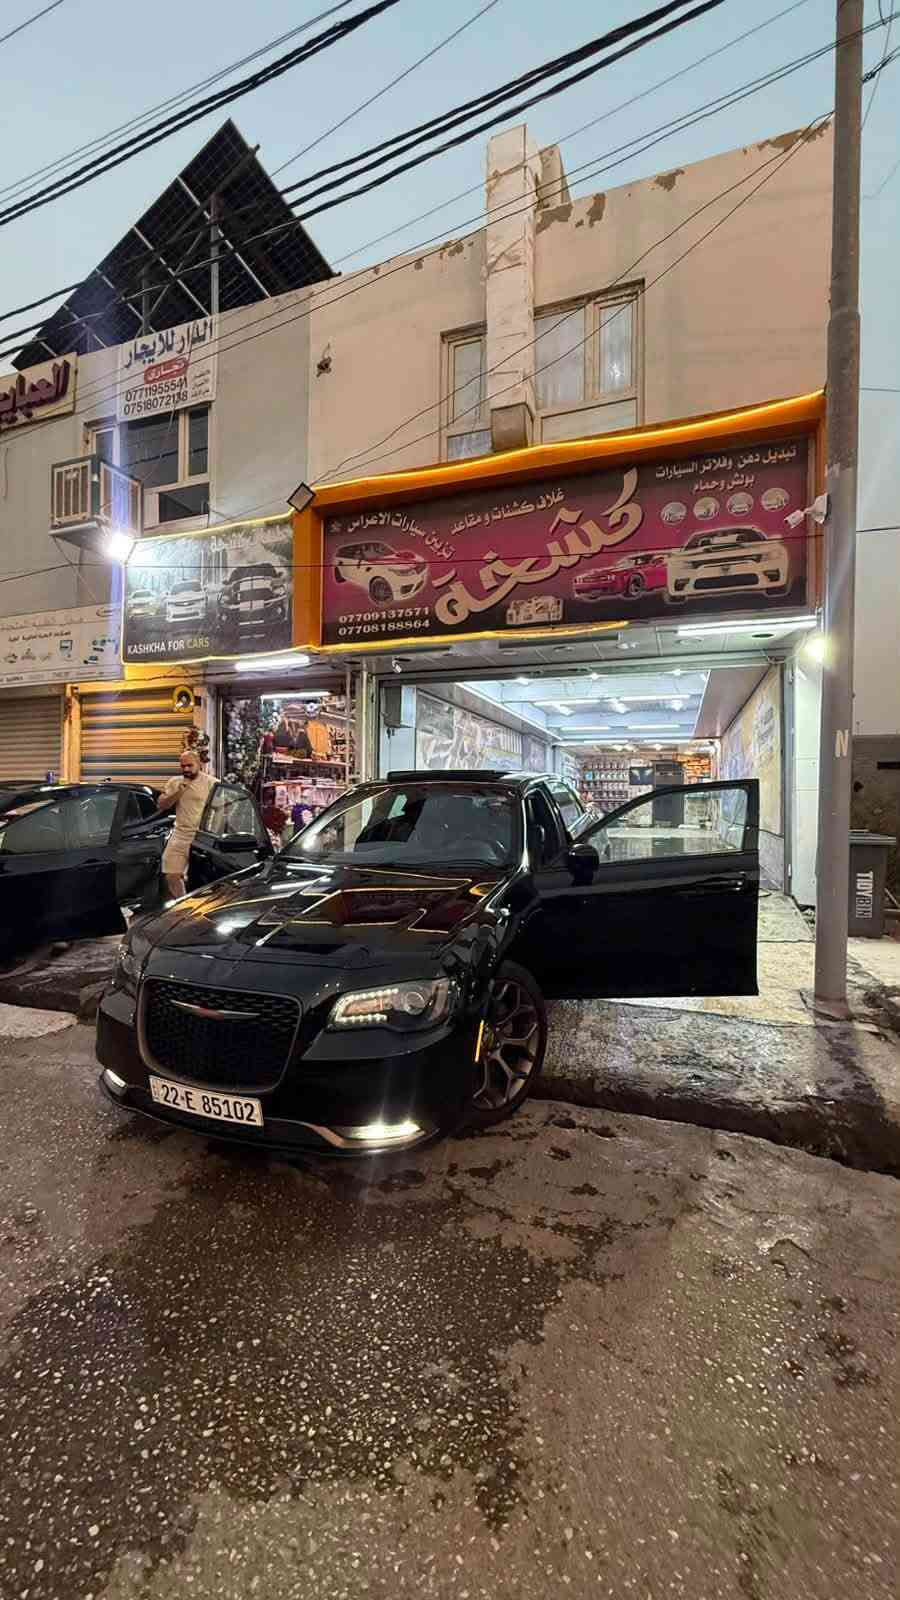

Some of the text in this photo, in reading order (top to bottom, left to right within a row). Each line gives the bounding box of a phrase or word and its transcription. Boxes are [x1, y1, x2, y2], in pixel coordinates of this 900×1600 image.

[737, 451, 761, 469] دهن
[762, 445, 796, 464] تبديل
[655, 461, 698, 480] السيارات
[390, 512, 425, 537] سيارات
[451, 514, 484, 535] مقاعد
[127, 637, 210, 655] KASHKHA FOR CARS
[202, 1095, 257, 1122] 85102
